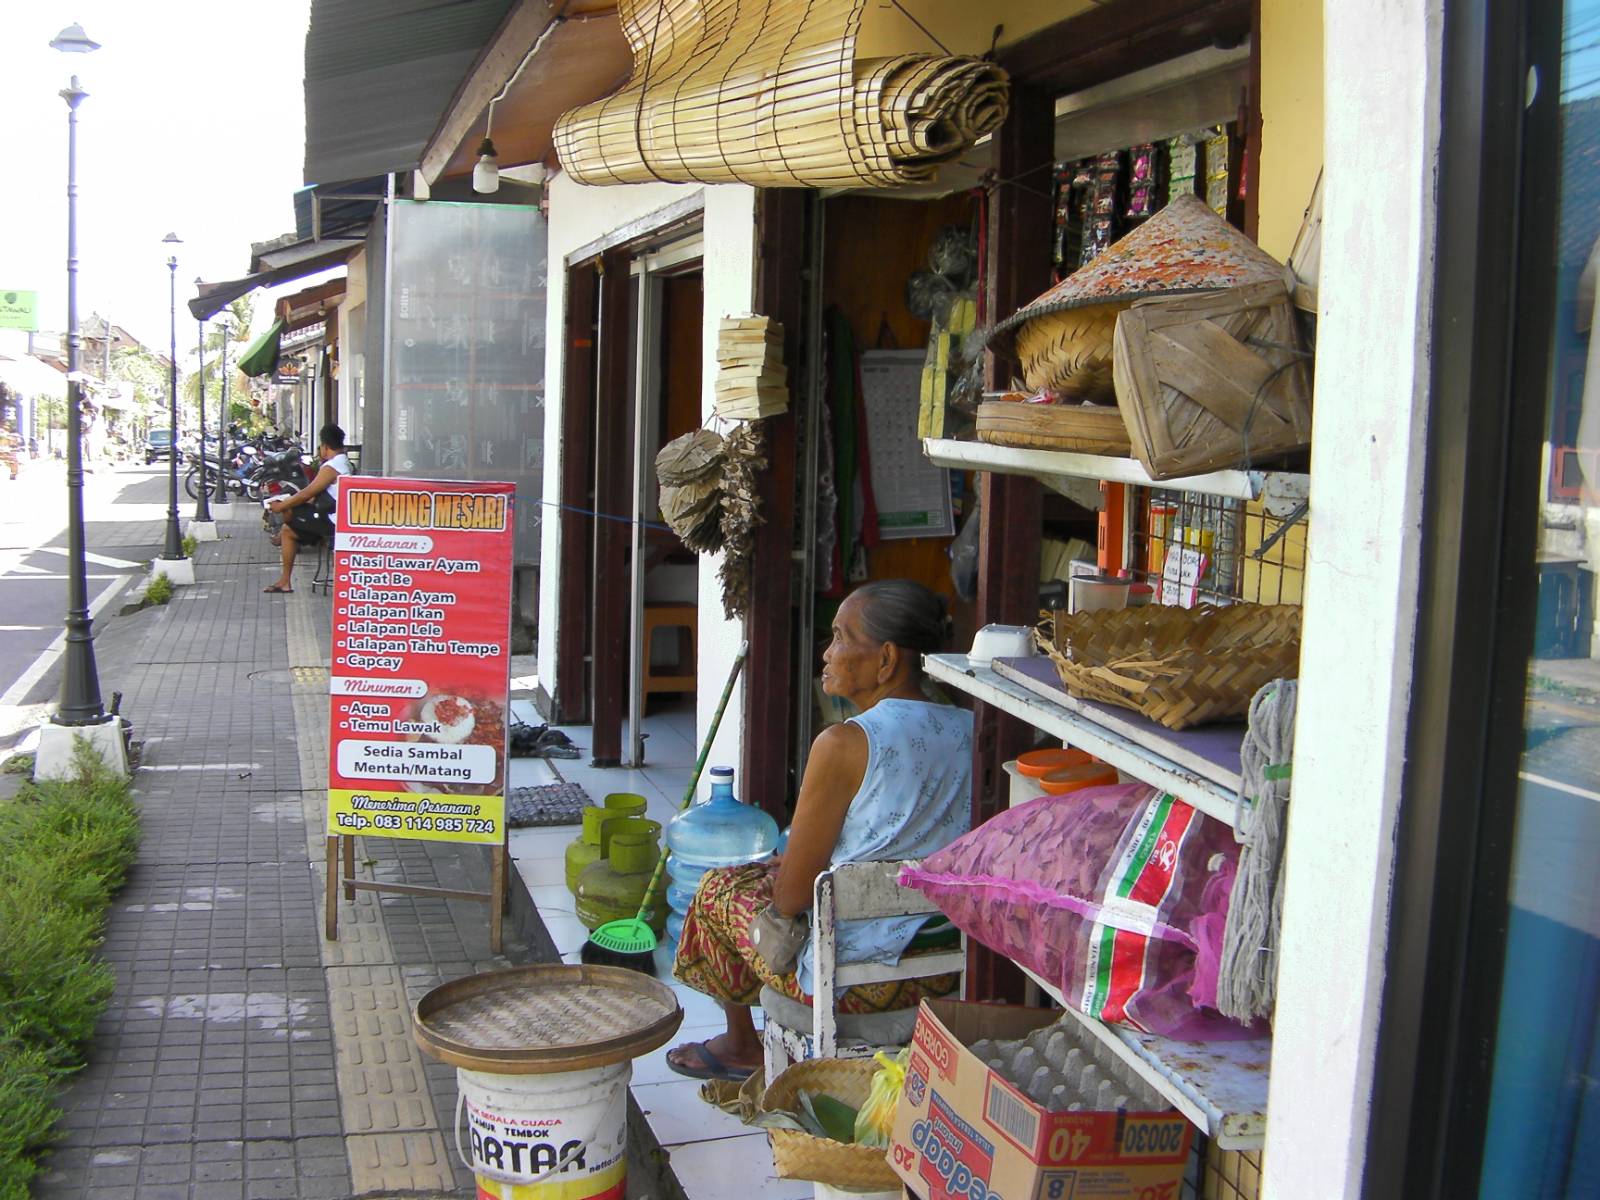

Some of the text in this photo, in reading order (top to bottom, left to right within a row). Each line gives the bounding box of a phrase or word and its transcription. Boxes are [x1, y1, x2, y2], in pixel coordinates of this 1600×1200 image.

[350, 491, 504, 529] WARUNG MESARI
[349, 535, 418, 550] Makanan
[351, 556, 479, 573] Nasi Lawar Ayam
[350, 572, 411, 586] Tipat Be
[350, 588, 455, 606] Lalapan Ayam
[349, 605, 443, 619] Lalapan Ikan
[349, 621, 441, 636] Lalapan Lele
[348, 638, 499, 656] Lalapan Tahu Tempe
[347, 655, 401, 670] Capcay
[344, 679, 412, 694] Minuman
[350, 703, 389, 717] Aqua
[351, 719, 441, 733] Temu Lawak
[363, 745, 462, 760] Sedia Sambal
[354, 761, 471, 779] Mentah/Matang
[352, 796, 472, 815] Menerima Pesanan
[337, 813, 495, 833] Telp. 083 114 985 724
[914, 1017, 950, 1068] GORENG
[521, 1118, 563, 1127] CUACA
[504, 1127, 550, 1139] TEMBOK
[1124, 1123, 1183, 1149] 20030
[1050, 1128, 1092, 1162] 40
